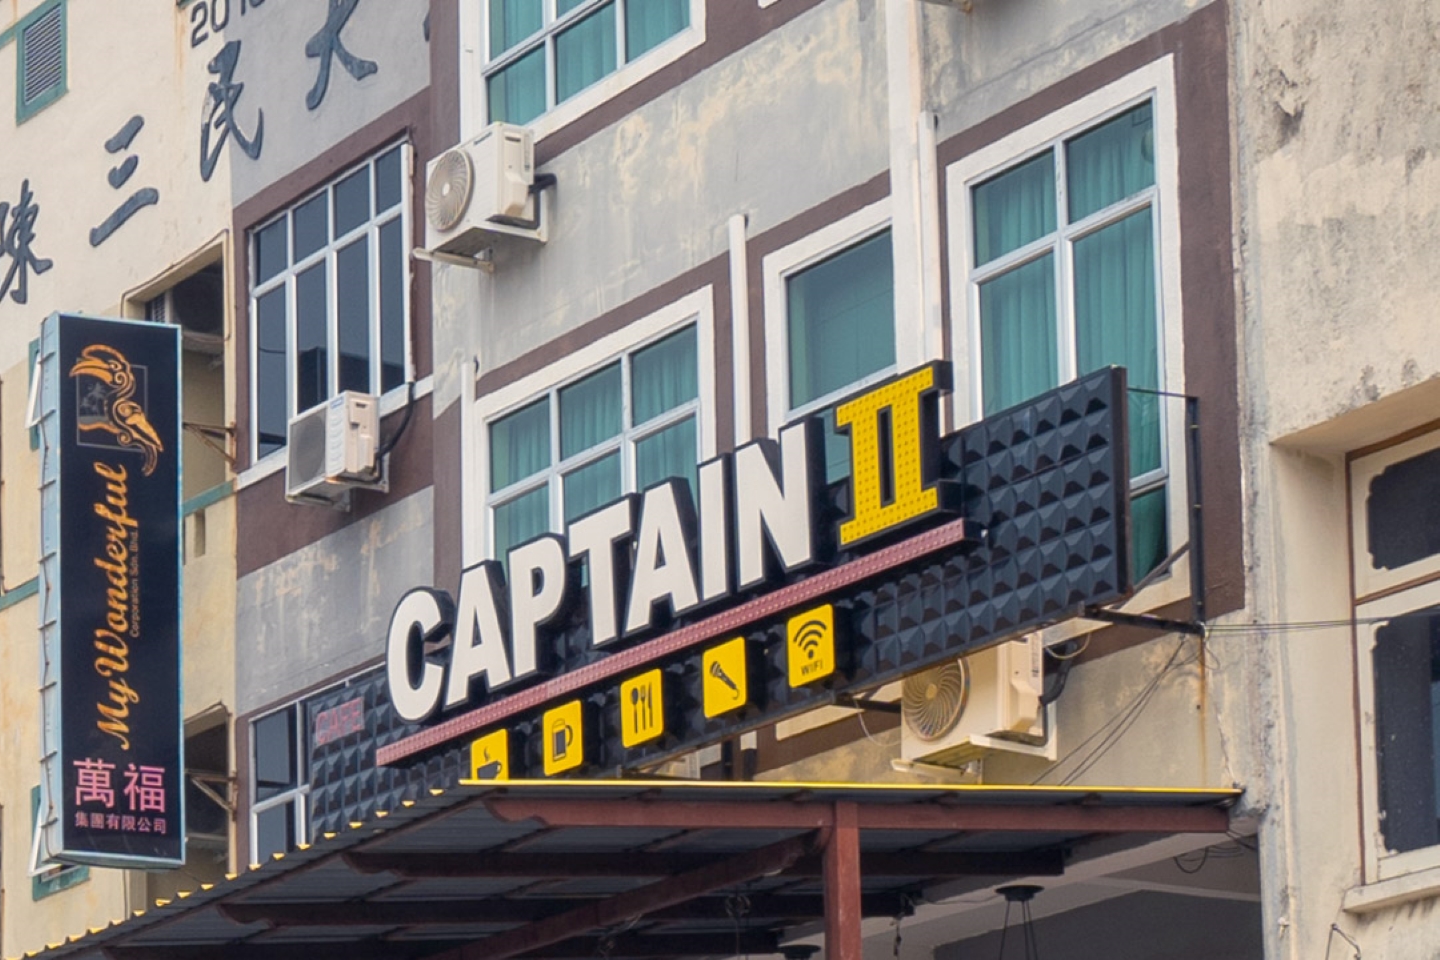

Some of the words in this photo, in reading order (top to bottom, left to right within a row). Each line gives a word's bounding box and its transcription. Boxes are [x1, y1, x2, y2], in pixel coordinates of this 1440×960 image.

[386, 418, 822, 723] CAPTAIN
[836, 365, 947, 546] II
[128, 577, 141, 639] Corporation
[800, 658, 823, 676] WIFI
[315, 696, 364, 745] CAFE
[73, 757, 166, 813] 萬福
